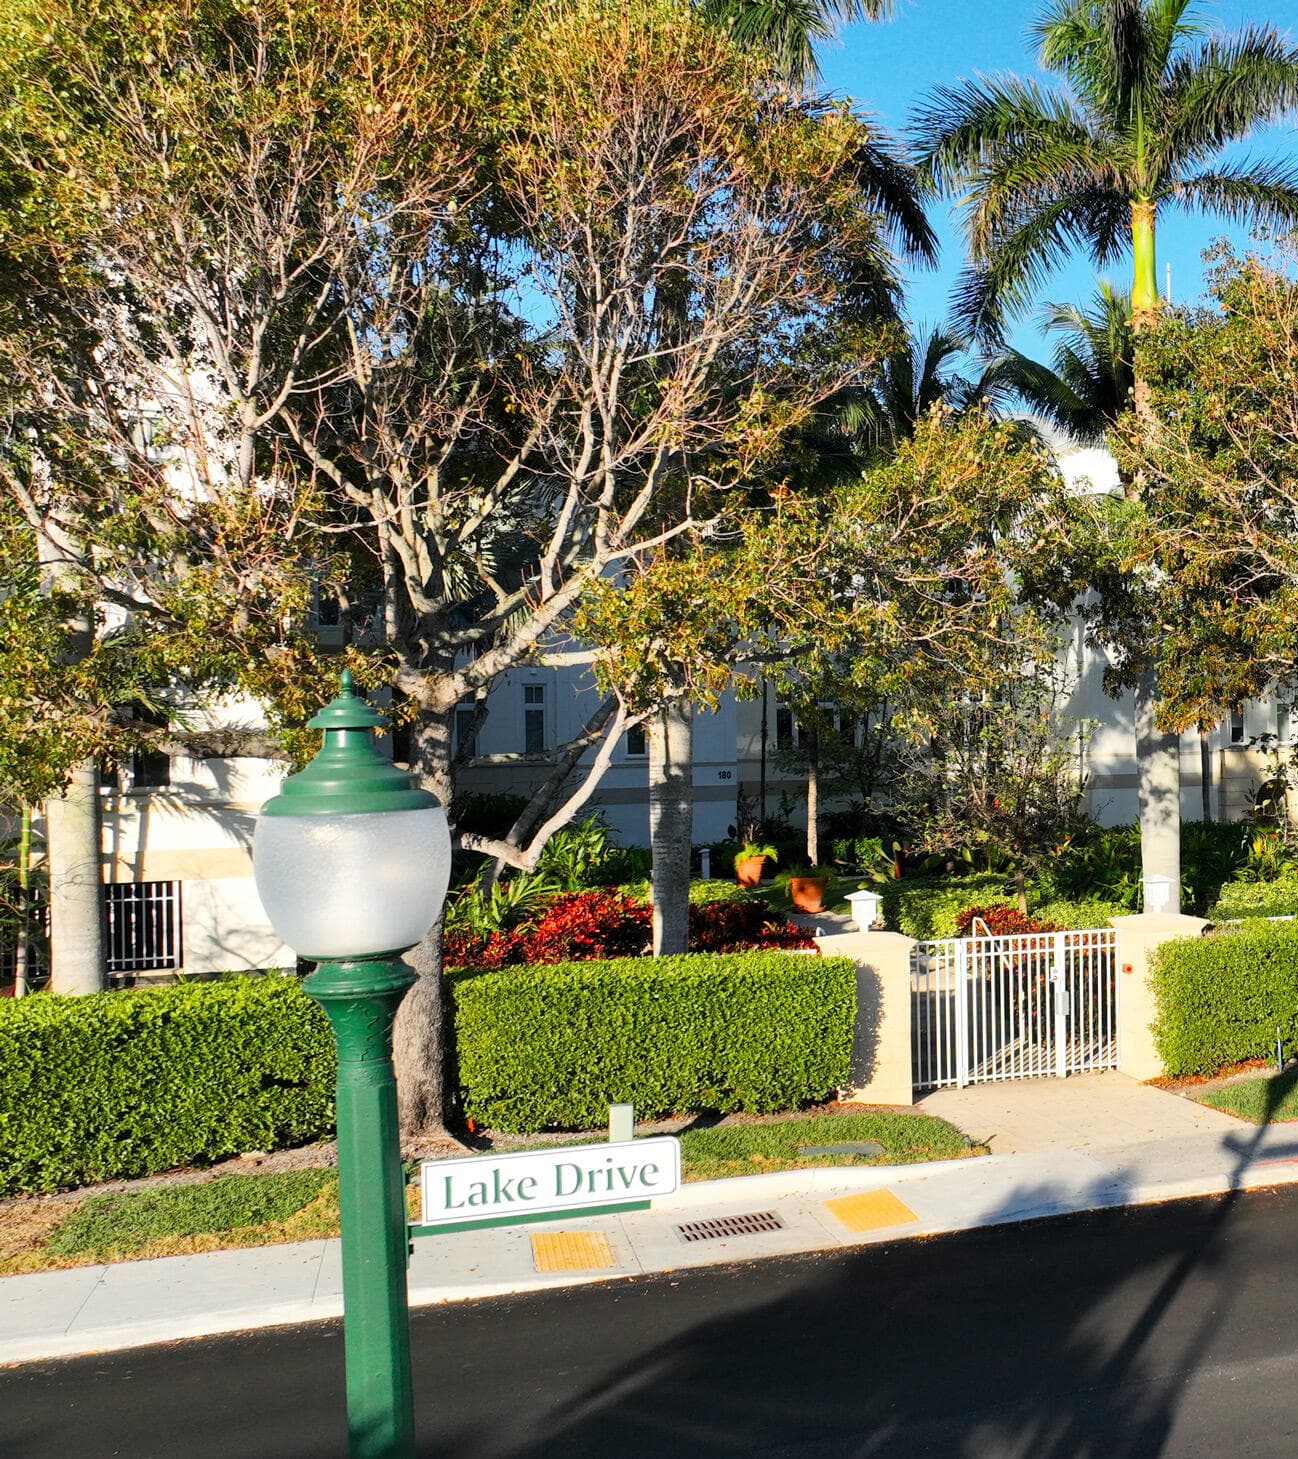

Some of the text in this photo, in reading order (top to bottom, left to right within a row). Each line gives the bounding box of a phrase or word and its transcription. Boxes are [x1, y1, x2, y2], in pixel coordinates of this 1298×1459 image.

[718, 770, 732, 780] 180
[443, 1157, 659, 1210] Lake Drive
